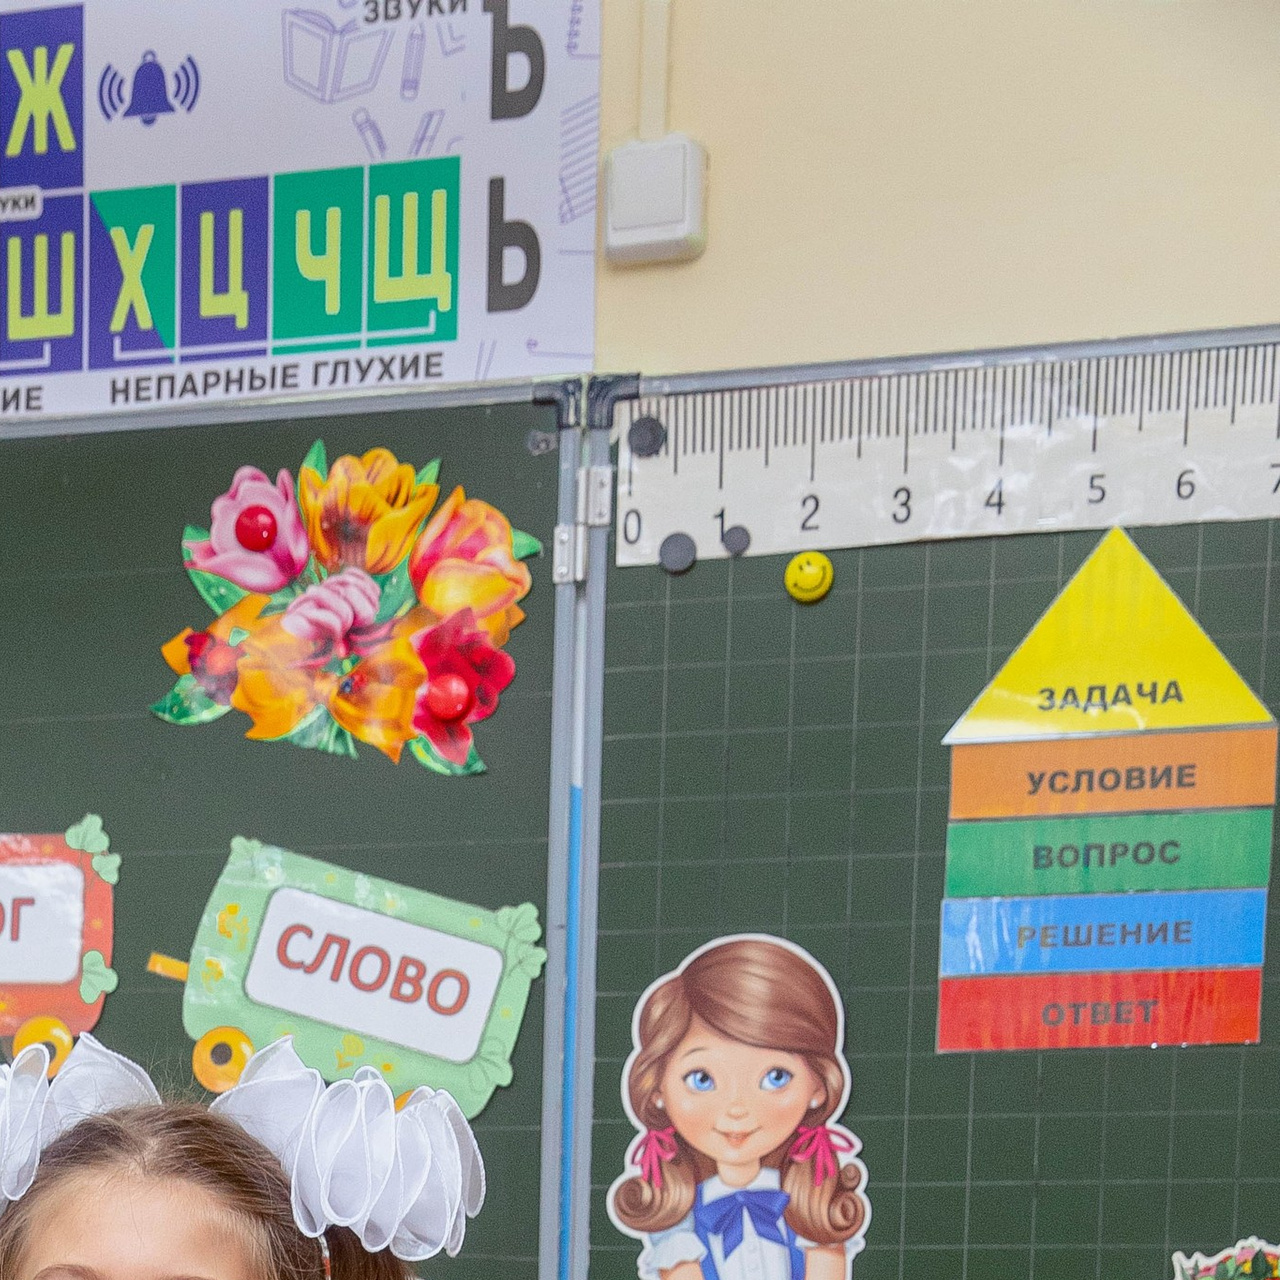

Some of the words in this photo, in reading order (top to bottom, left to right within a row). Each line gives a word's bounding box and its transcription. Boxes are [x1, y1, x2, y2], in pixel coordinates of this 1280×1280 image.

[109, 363, 300, 405] НЕПАРНЫЕ
[311, 351, 444, 388] ГЛУХИЕ
[624, 508, 642, 545] 0
[714, 507, 726, 543] 1
[800, 494, 820, 531] 2
[893, 487, 913, 524] 3
[984, 479, 1006, 516] 4
[1088, 473, 1106, 504] 5
[1176, 468, 1196, 500] 6
[1038, 680, 1184, 713] ЗАДАЧА
[1027, 763, 1197, 796] УСЛОВИЕ
[1033, 840, 1181, 871] ВОПРОС
[1017, 920, 1193, 949] РЕШЕНИЕ
[275, 923, 472, 1017] СЛОВО
[1041, 999, 1159, 1027] ОТВЕТ
